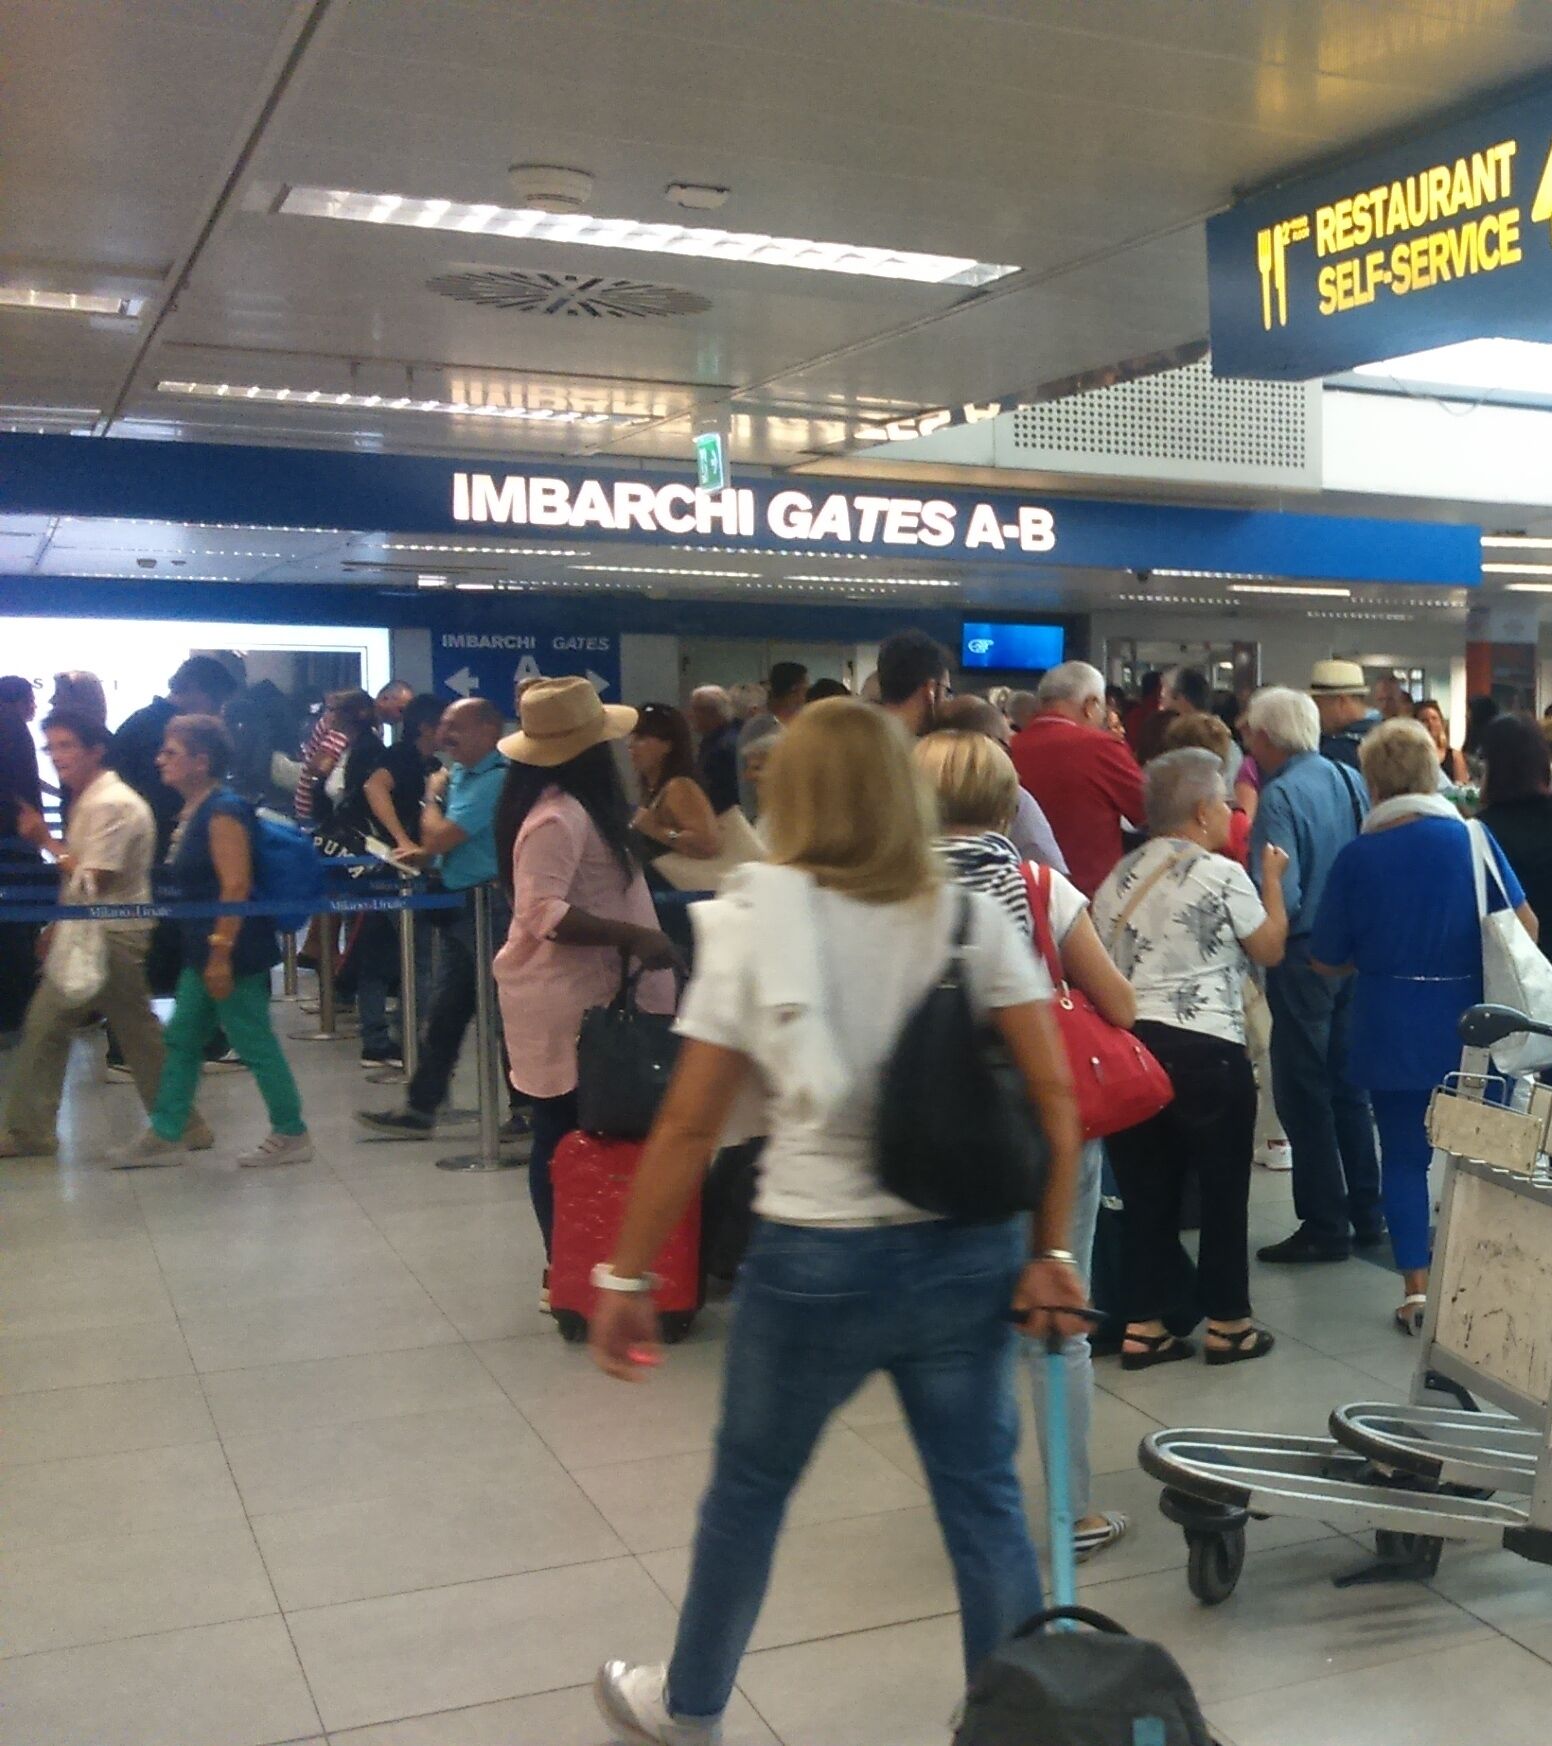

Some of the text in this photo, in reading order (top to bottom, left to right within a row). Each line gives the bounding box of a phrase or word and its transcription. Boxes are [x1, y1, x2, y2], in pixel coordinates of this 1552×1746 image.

[1316, 140, 1516, 257] RESTAURANT
[1318, 207, 1522, 316] SELF-SERVICE
[452, 472, 1056, 552] IMBARCHI GATES A-B
[441, 634, 610, 650] IMBARCHI GATES
[513, 655, 542, 681] A
